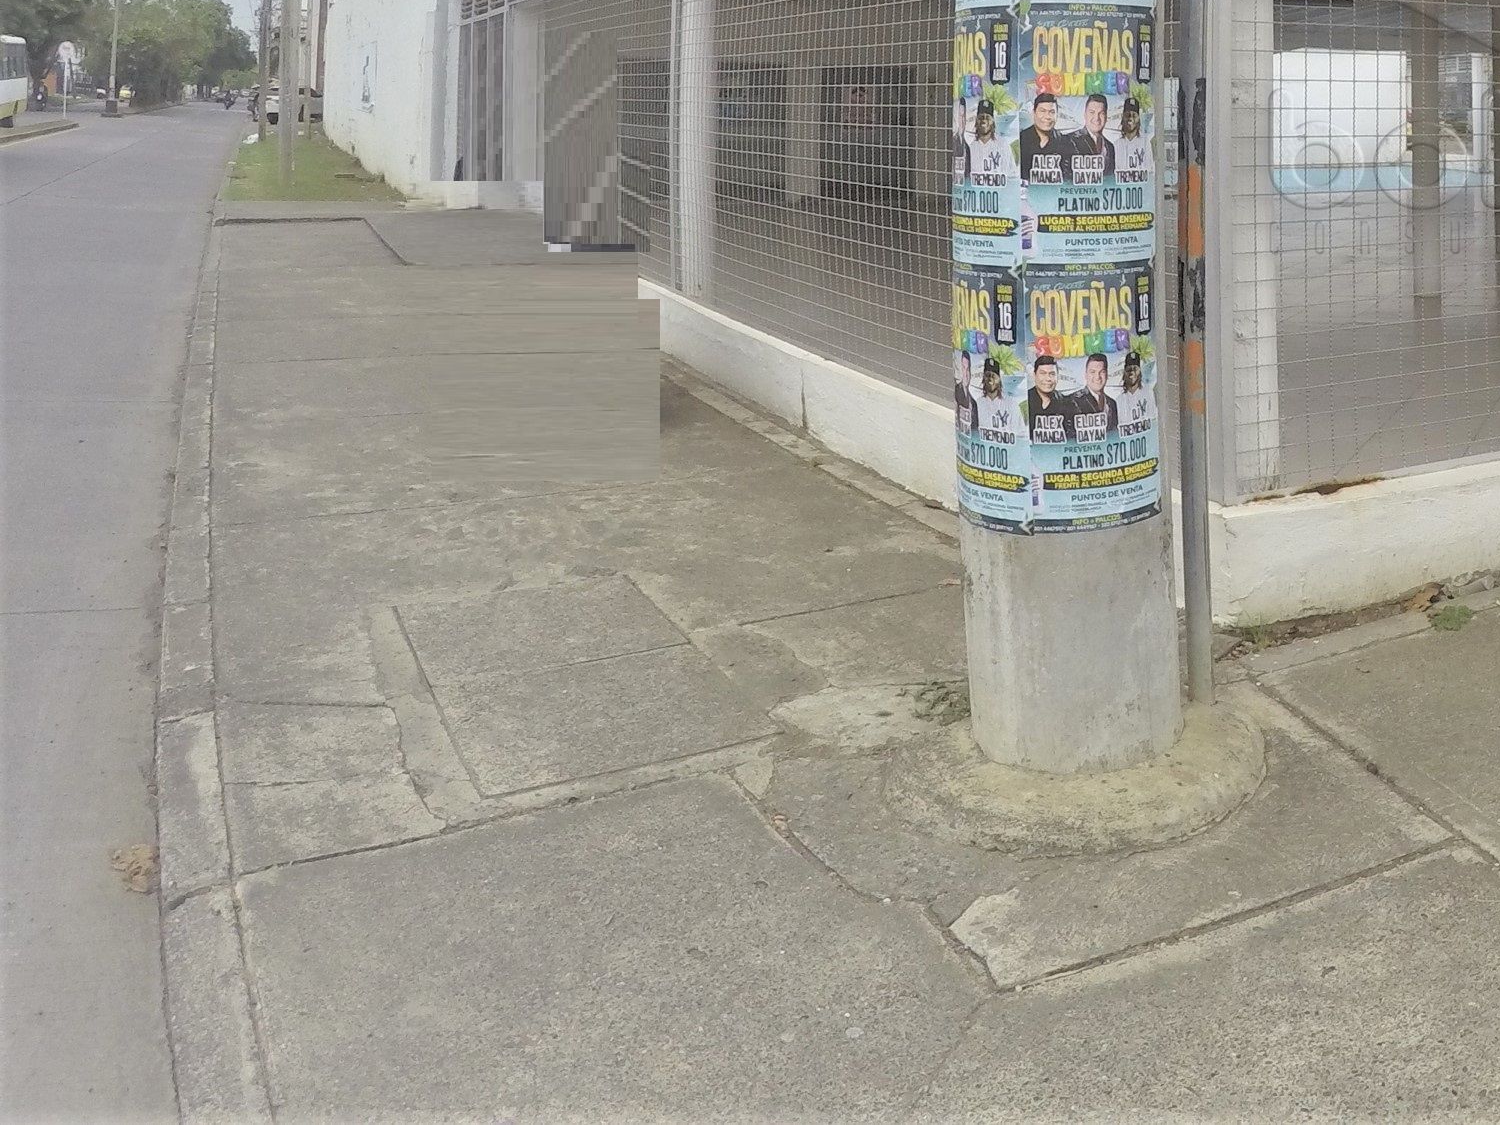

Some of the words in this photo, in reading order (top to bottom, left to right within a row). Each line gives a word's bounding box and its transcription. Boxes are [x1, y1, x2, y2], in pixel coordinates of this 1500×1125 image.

[1033, 21, 1133, 73] COVEÑAS
[1140, 41, 1150, 67] 16
[995, 42, 1007, 68] 16
[1033, 155, 1061, 169] ALEX
[1073, 155, 1103, 169] ELDER
[971, 173, 1006, 186] TREMENDO
[1030, 170, 1063, 184] MANGA
[1073, 171, 1102, 184] DAYAN
[1116, 170, 1148, 183] TREMENDO
[964, 190, 999, 214] $70.000
[1058, 197, 1100, 212] PLATINO
[1103, 187, 1143, 210] $70.000
[1040, 216, 1074, 224] LUGAR:
[1077, 216, 1117, 224] SEGUNDA
[971, 239, 994, 247] VENTA
[1065, 238, 1096, 246] PUNTOS
[1114, 236, 1138, 245] VENTA
[1031, 281, 1132, 336] COVEÑAS
[1139, 293, 1149, 319] 16
[998, 302, 1012, 329] 16
[1036, 415, 1064, 429] ALEX
[1075, 414, 1106, 427] ELDER
[1077, 428, 1106, 442] DAYAN
[1119, 419, 1151, 437] TREMENDO
[980, 427, 1015, 445] TREMENDO
[1034, 430, 1066, 444] MANGA
[970, 442, 1008, 470] $70.000
[1063, 453, 1105, 470] PLATINO
[1107, 438, 1147, 464] $70.000
[1045, 473, 1079, 483] LUGAR:
[1082, 468, 1122, 482] SEGUNDA
[980, 490, 1004, 502] VENTA
[1071, 493, 1107, 502] PUNTOS
[1108, 489, 1120, 498] DE
[1121, 484, 1144, 496] VENTA
